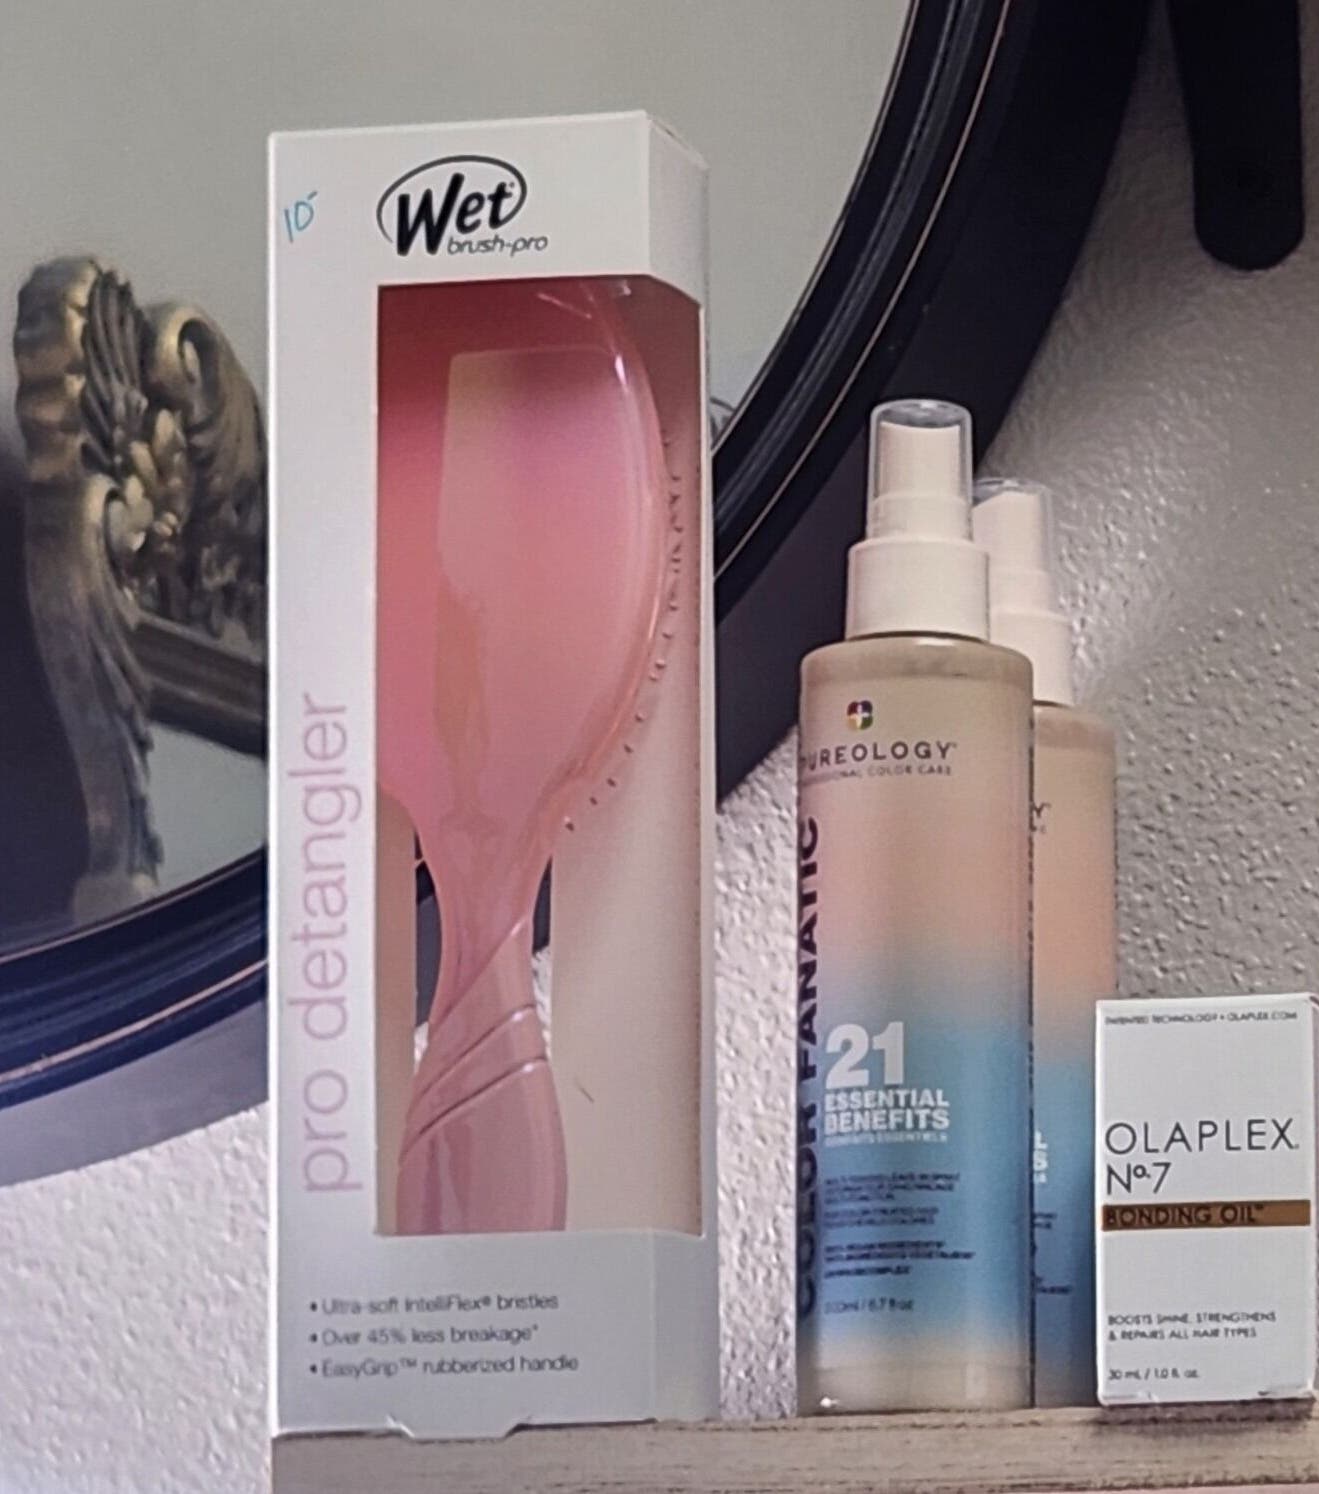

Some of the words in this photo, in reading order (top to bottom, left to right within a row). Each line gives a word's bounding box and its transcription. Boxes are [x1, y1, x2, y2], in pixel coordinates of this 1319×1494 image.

[396, 172, 512, 257] Wet
[447, 234, 549, 258] brush-pro
[288, 693, 363, 1043] detangler
[825, 1021, 904, 1090] 21
[824, 1089, 949, 1113] ESSENTIAL
[301, 1067, 362, 1194] pro
[824, 1109, 950, 1135] BENEFITS
[1105, 1118, 1296, 1155] OLAPLEX
[1105, 1206, 1212, 1228] BONDING
[496, 1294, 559, 1311] bristles
[321, 1330, 361, 1346] Over
[367, 1329, 406, 1345] 45%
[411, 1328, 445, 1344] less
[1168, 1328, 1190, 1340] ALL
[1223, 1326, 1258, 1338] TYPES
[423, 1356, 515, 1374] rubberized
[519, 1355, 579, 1372] handle
